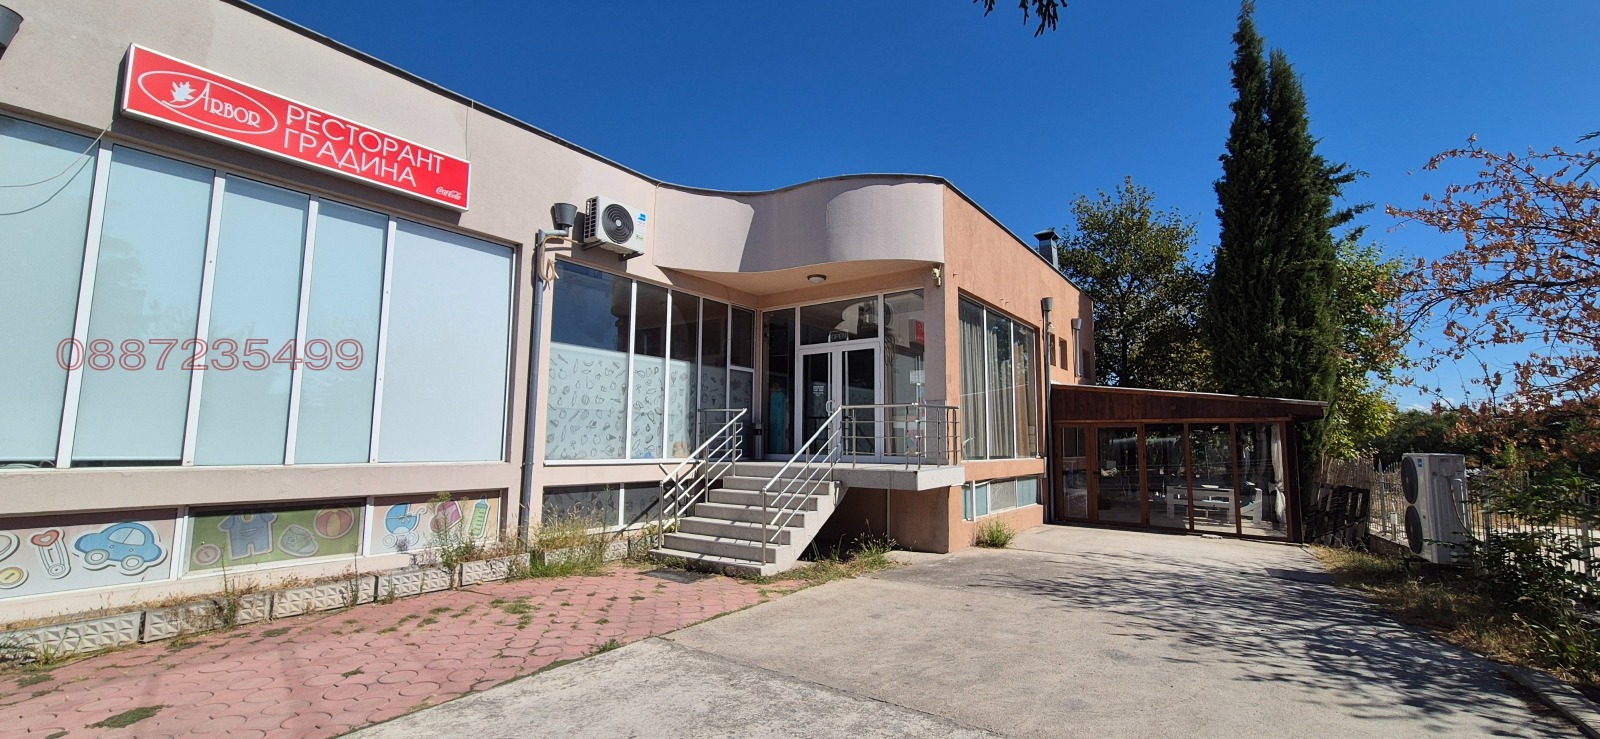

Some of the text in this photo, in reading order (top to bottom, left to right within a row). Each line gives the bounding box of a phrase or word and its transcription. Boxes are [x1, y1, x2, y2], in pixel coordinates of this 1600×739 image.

[163, 82, 261, 128] ARBOR
[284, 128, 416, 187] ГРАДИНА
[286, 105, 444, 174] РЕСТОРАНТ
